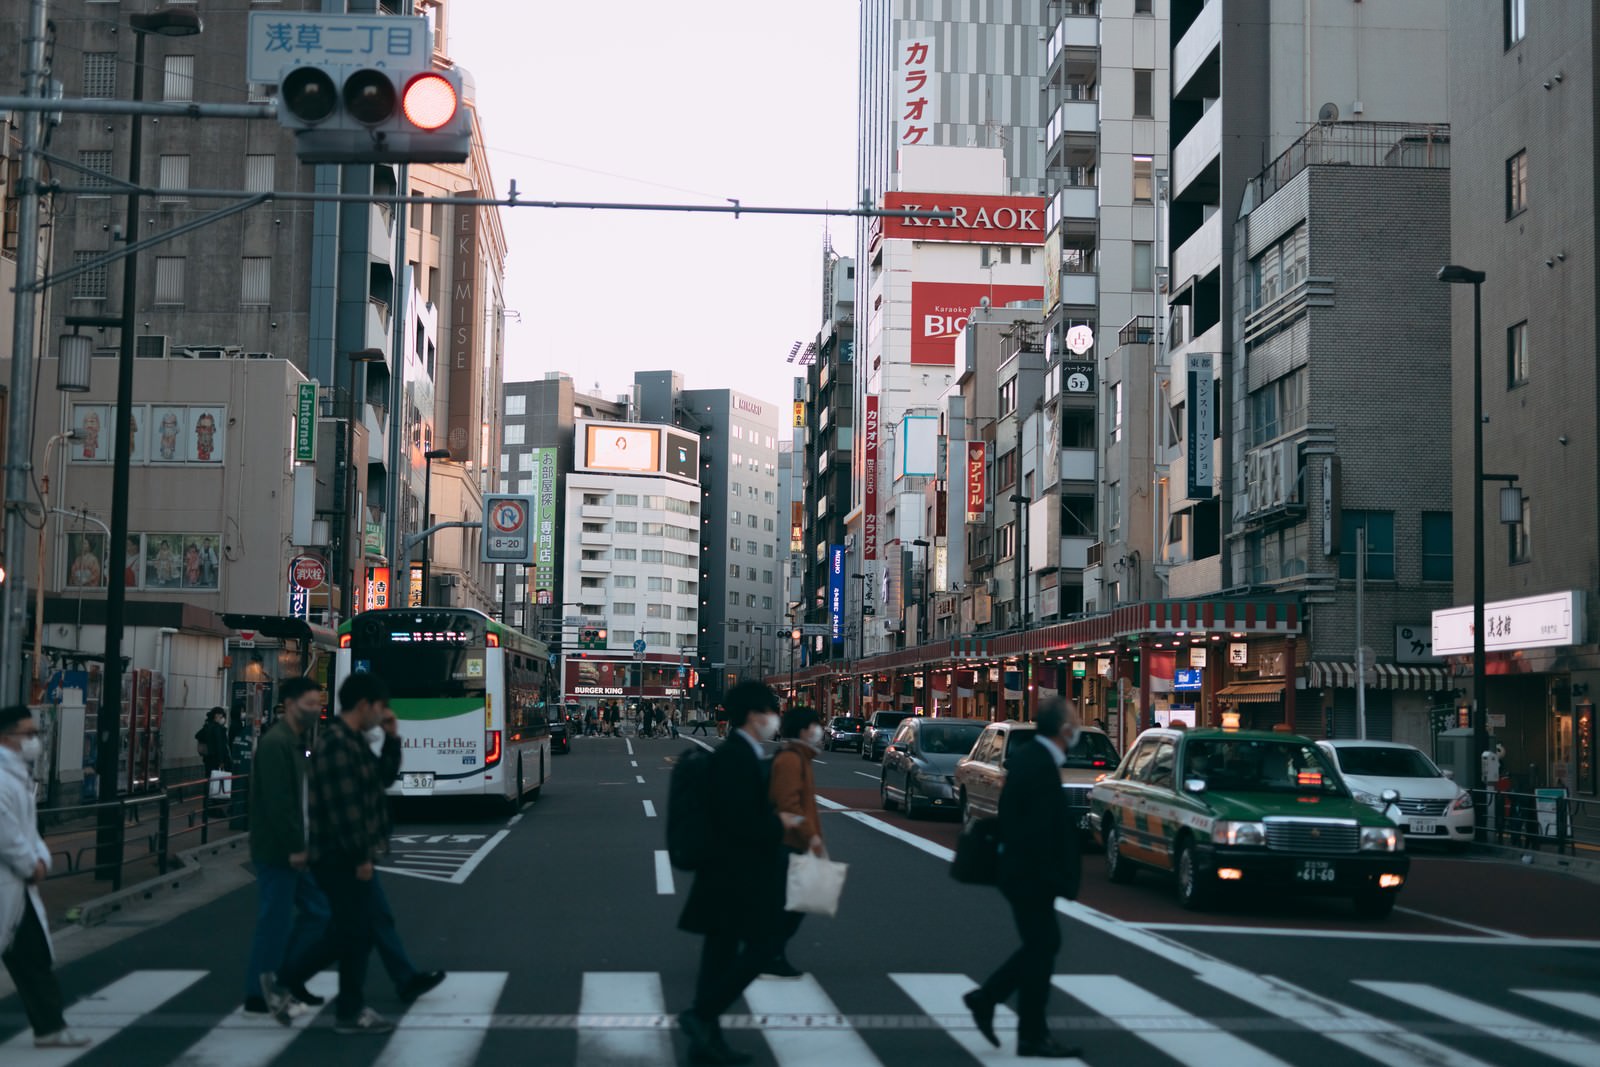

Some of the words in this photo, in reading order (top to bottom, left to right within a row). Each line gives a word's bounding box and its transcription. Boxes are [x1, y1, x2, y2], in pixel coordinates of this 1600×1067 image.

[265, 23, 412, 55] 浅草二丁目
[902, 42, 929, 145] カラオケ
[901, 203, 1046, 231] KARAOK
[455, 214, 471, 369] EKIMISE
[935, 305, 967, 313] Karaoke
[1071, 377, 1085, 389] 5F
[299, 400, 312, 452] Internet
[866, 410, 878, 451] カラオケ
[1200, 379, 1208, 480] マンスリーマンション
[970, 461, 982, 505] アイフル
[540, 451, 554, 562] お部屋探し専門店
[495, 539, 519, 548] 8-20
[865, 513, 877, 554] カラオケ
[297, 568, 322, 580] 消火栓
